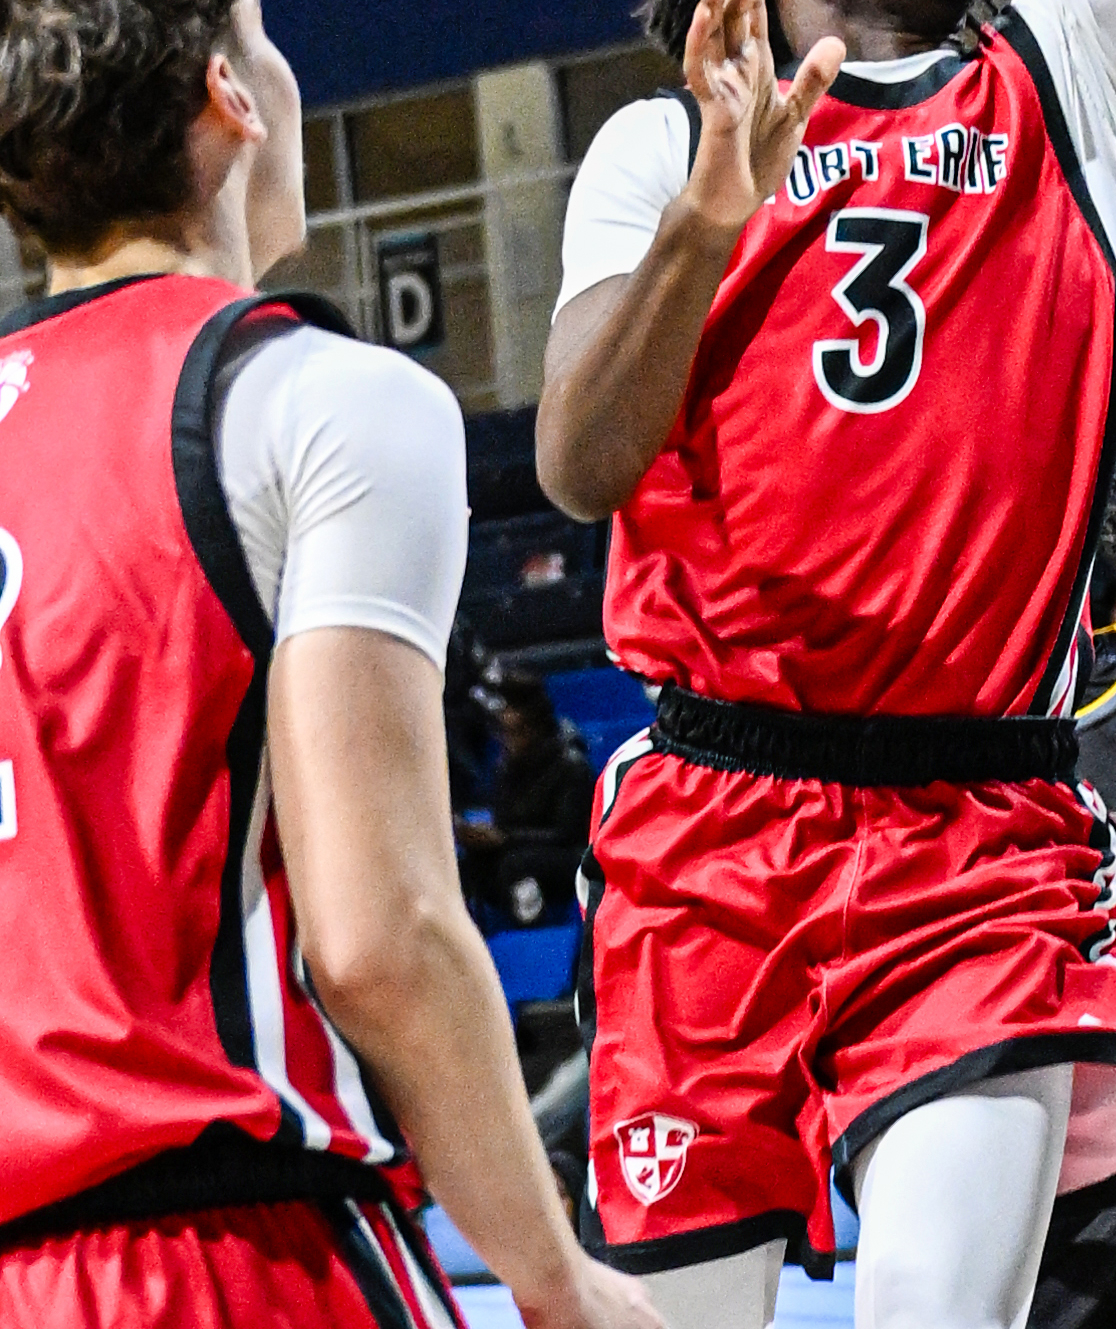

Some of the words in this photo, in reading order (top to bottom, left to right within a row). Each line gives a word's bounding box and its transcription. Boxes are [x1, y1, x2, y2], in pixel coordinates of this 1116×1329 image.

[763, 138, 882, 206] ORT
[901, 122, 1009, 195] ERIE
[388, 273, 432, 344] D
[812, 207, 929, 414] 3
